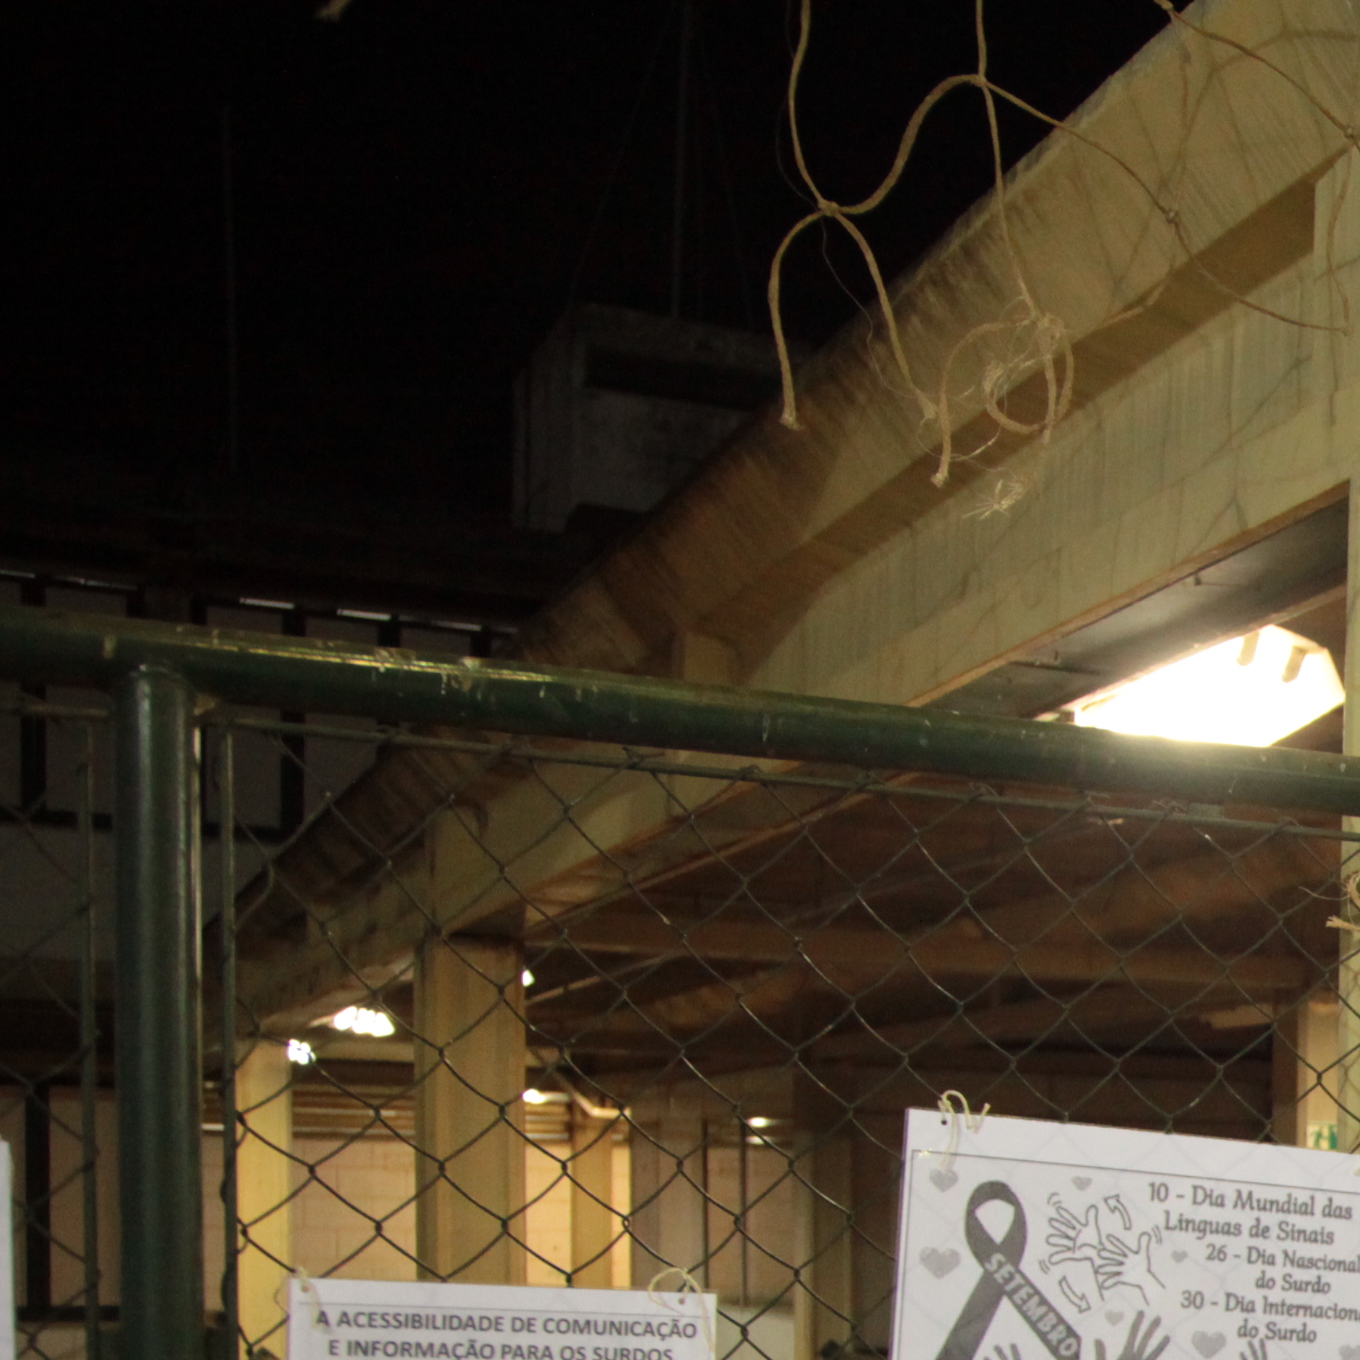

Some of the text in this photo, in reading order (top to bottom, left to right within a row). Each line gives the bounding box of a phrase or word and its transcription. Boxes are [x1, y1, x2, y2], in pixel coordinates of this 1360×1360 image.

[1149, 1182, 1169, 1202] 10
[1192, 1185, 1226, 1208] Dia
[1233, 1189, 1315, 1217] Mundial
[1321, 1198, 1353, 1219] das
[1249, 1218, 1271, 1239] de
[1276, 1221, 1335, 1245] Sinais
[1205, 1244, 1227, 1262] 26
[1247, 1246, 1276, 1267] Dia
[1255, 1270, 1331, 1294] do Surdo
[984, 1252, 1079, 1356] SETEMBRO
[1180, 1290, 1204, 1309] 30
[1225, 1292, 1256, 1313] Dia
[316, 1310, 697, 1341] A ACESSIBILIDADE DE COMUNICAÇÃO
[1237, 1319, 1317, 1343] do Surdo
[328, 1340, 340, 1356] E
[501, 1344, 553, 1360] PARA
